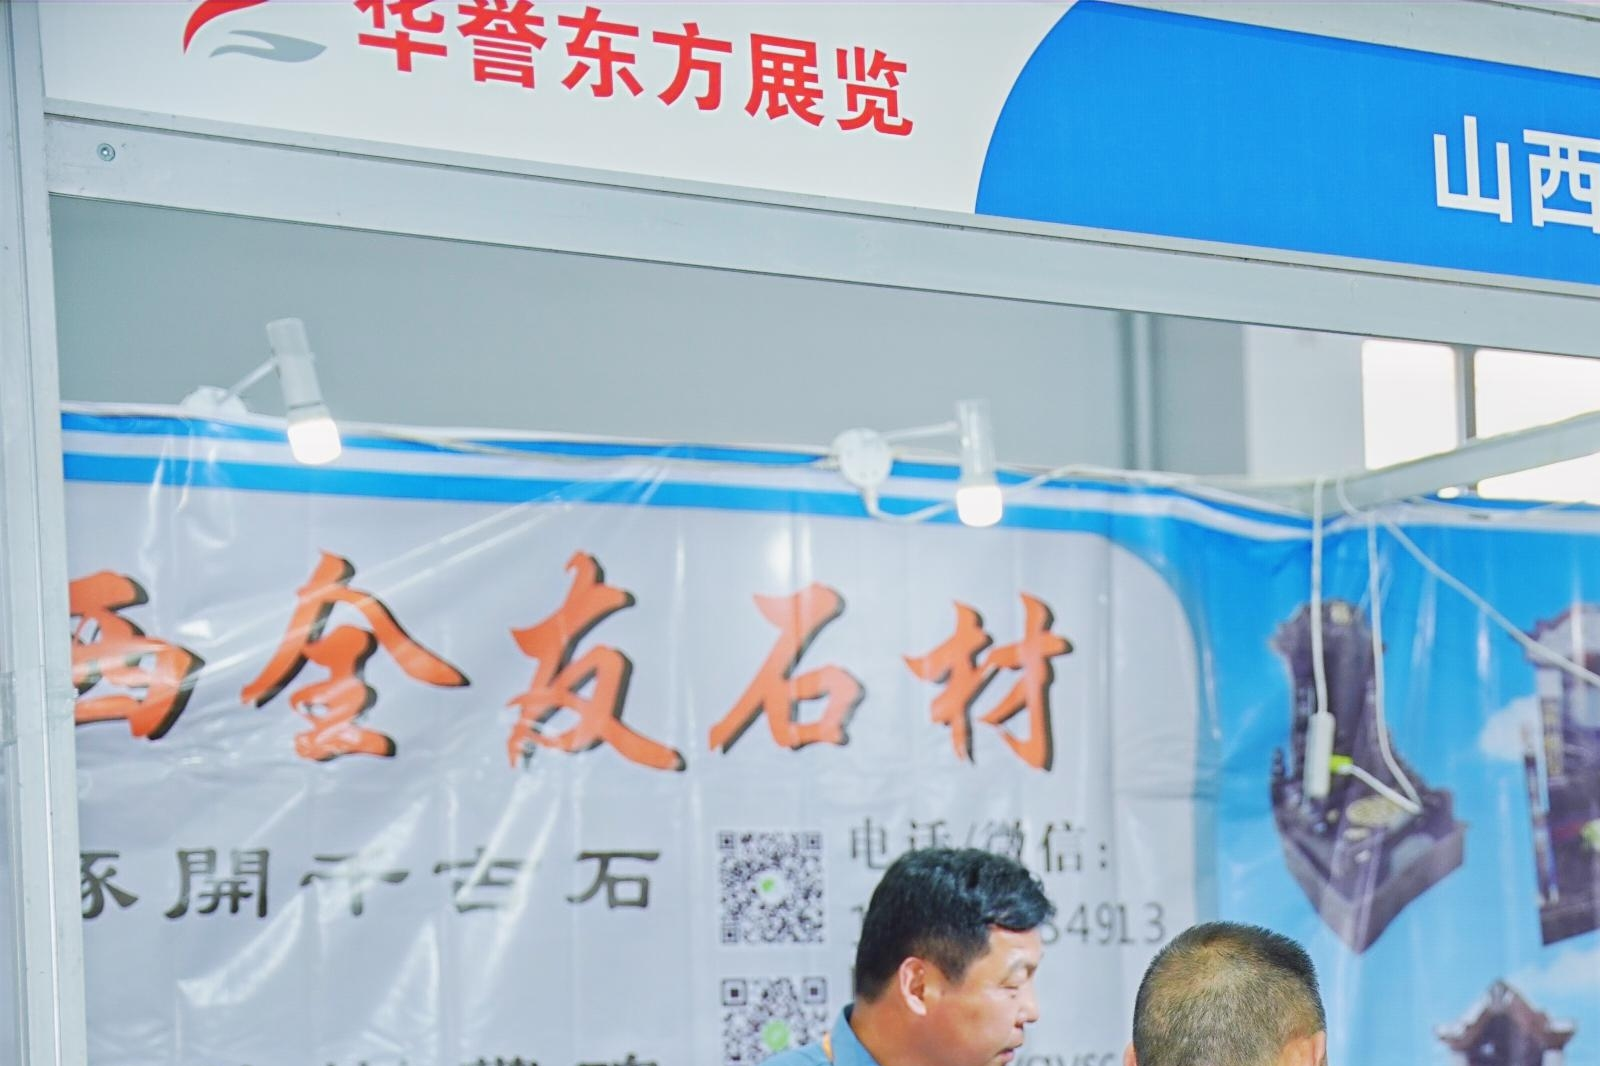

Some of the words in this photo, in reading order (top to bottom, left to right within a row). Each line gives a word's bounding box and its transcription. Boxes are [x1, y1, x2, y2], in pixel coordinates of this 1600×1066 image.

[355, 0, 914, 137] 华誉东方展览
